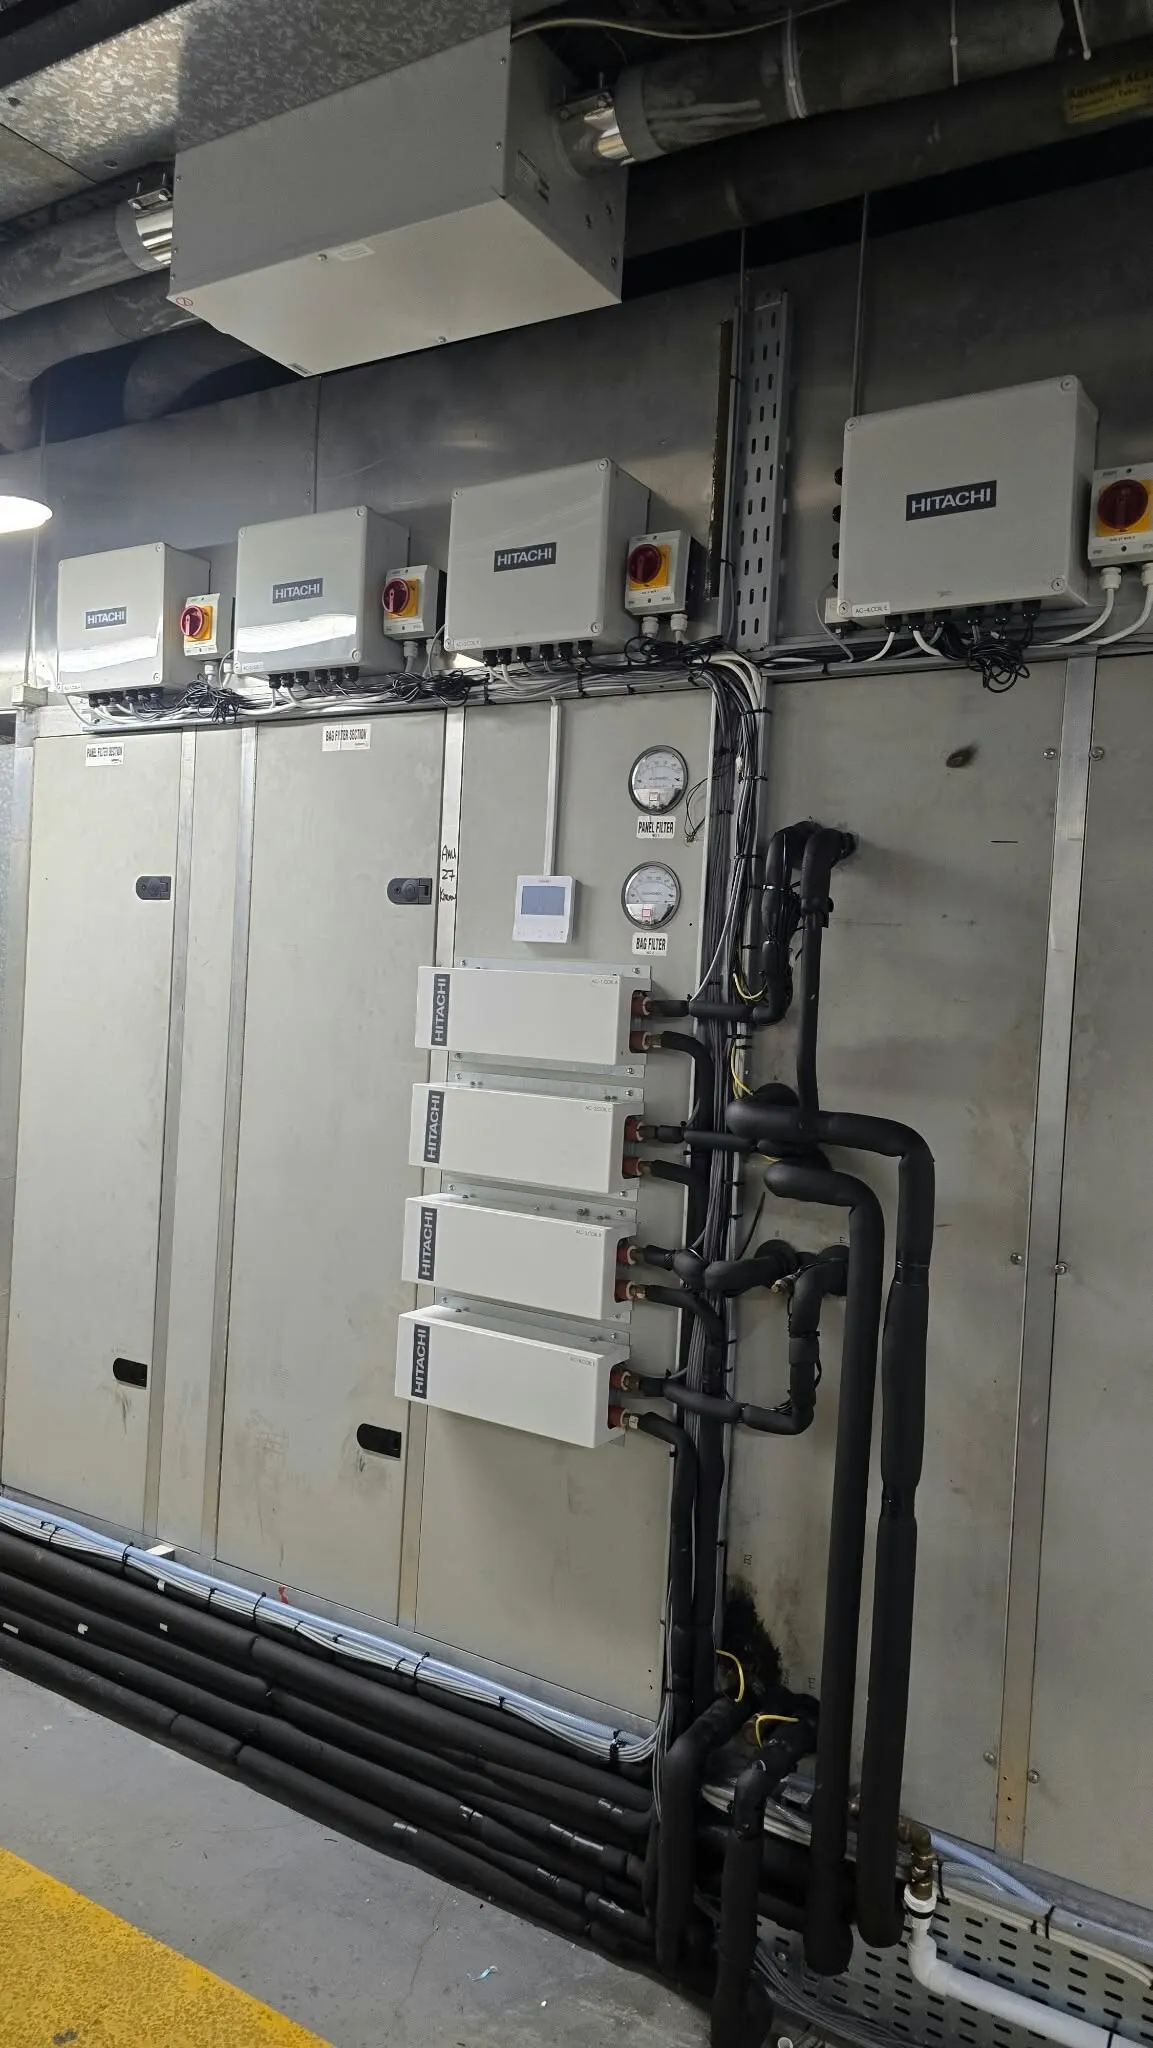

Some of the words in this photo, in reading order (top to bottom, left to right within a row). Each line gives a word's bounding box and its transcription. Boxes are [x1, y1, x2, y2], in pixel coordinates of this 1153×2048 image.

[911, 487, 991, 514] HITACHI
[497, 547, 552, 567] HITACHI
[275, 583, 321, 600] HITACHI
[87, 610, 125, 625] HITACHI
[325, 730, 335, 742] BAG
[349, 728, 367, 741] SECTION
[637, 821, 655, 834] PANEL
[655, 821, 674, 835] FILTER
[441, 868, 456, 882] 27
[635, 937, 648, 950] BAG
[647, 937, 666, 951] FILTER
[433, 977, 447, 1043] HITACHI
[427, 1094, 441, 1160] HITACHI
[421, 1211, 434, 1277] HITACHI
[414, 1328, 427, 1394] HITACHI
